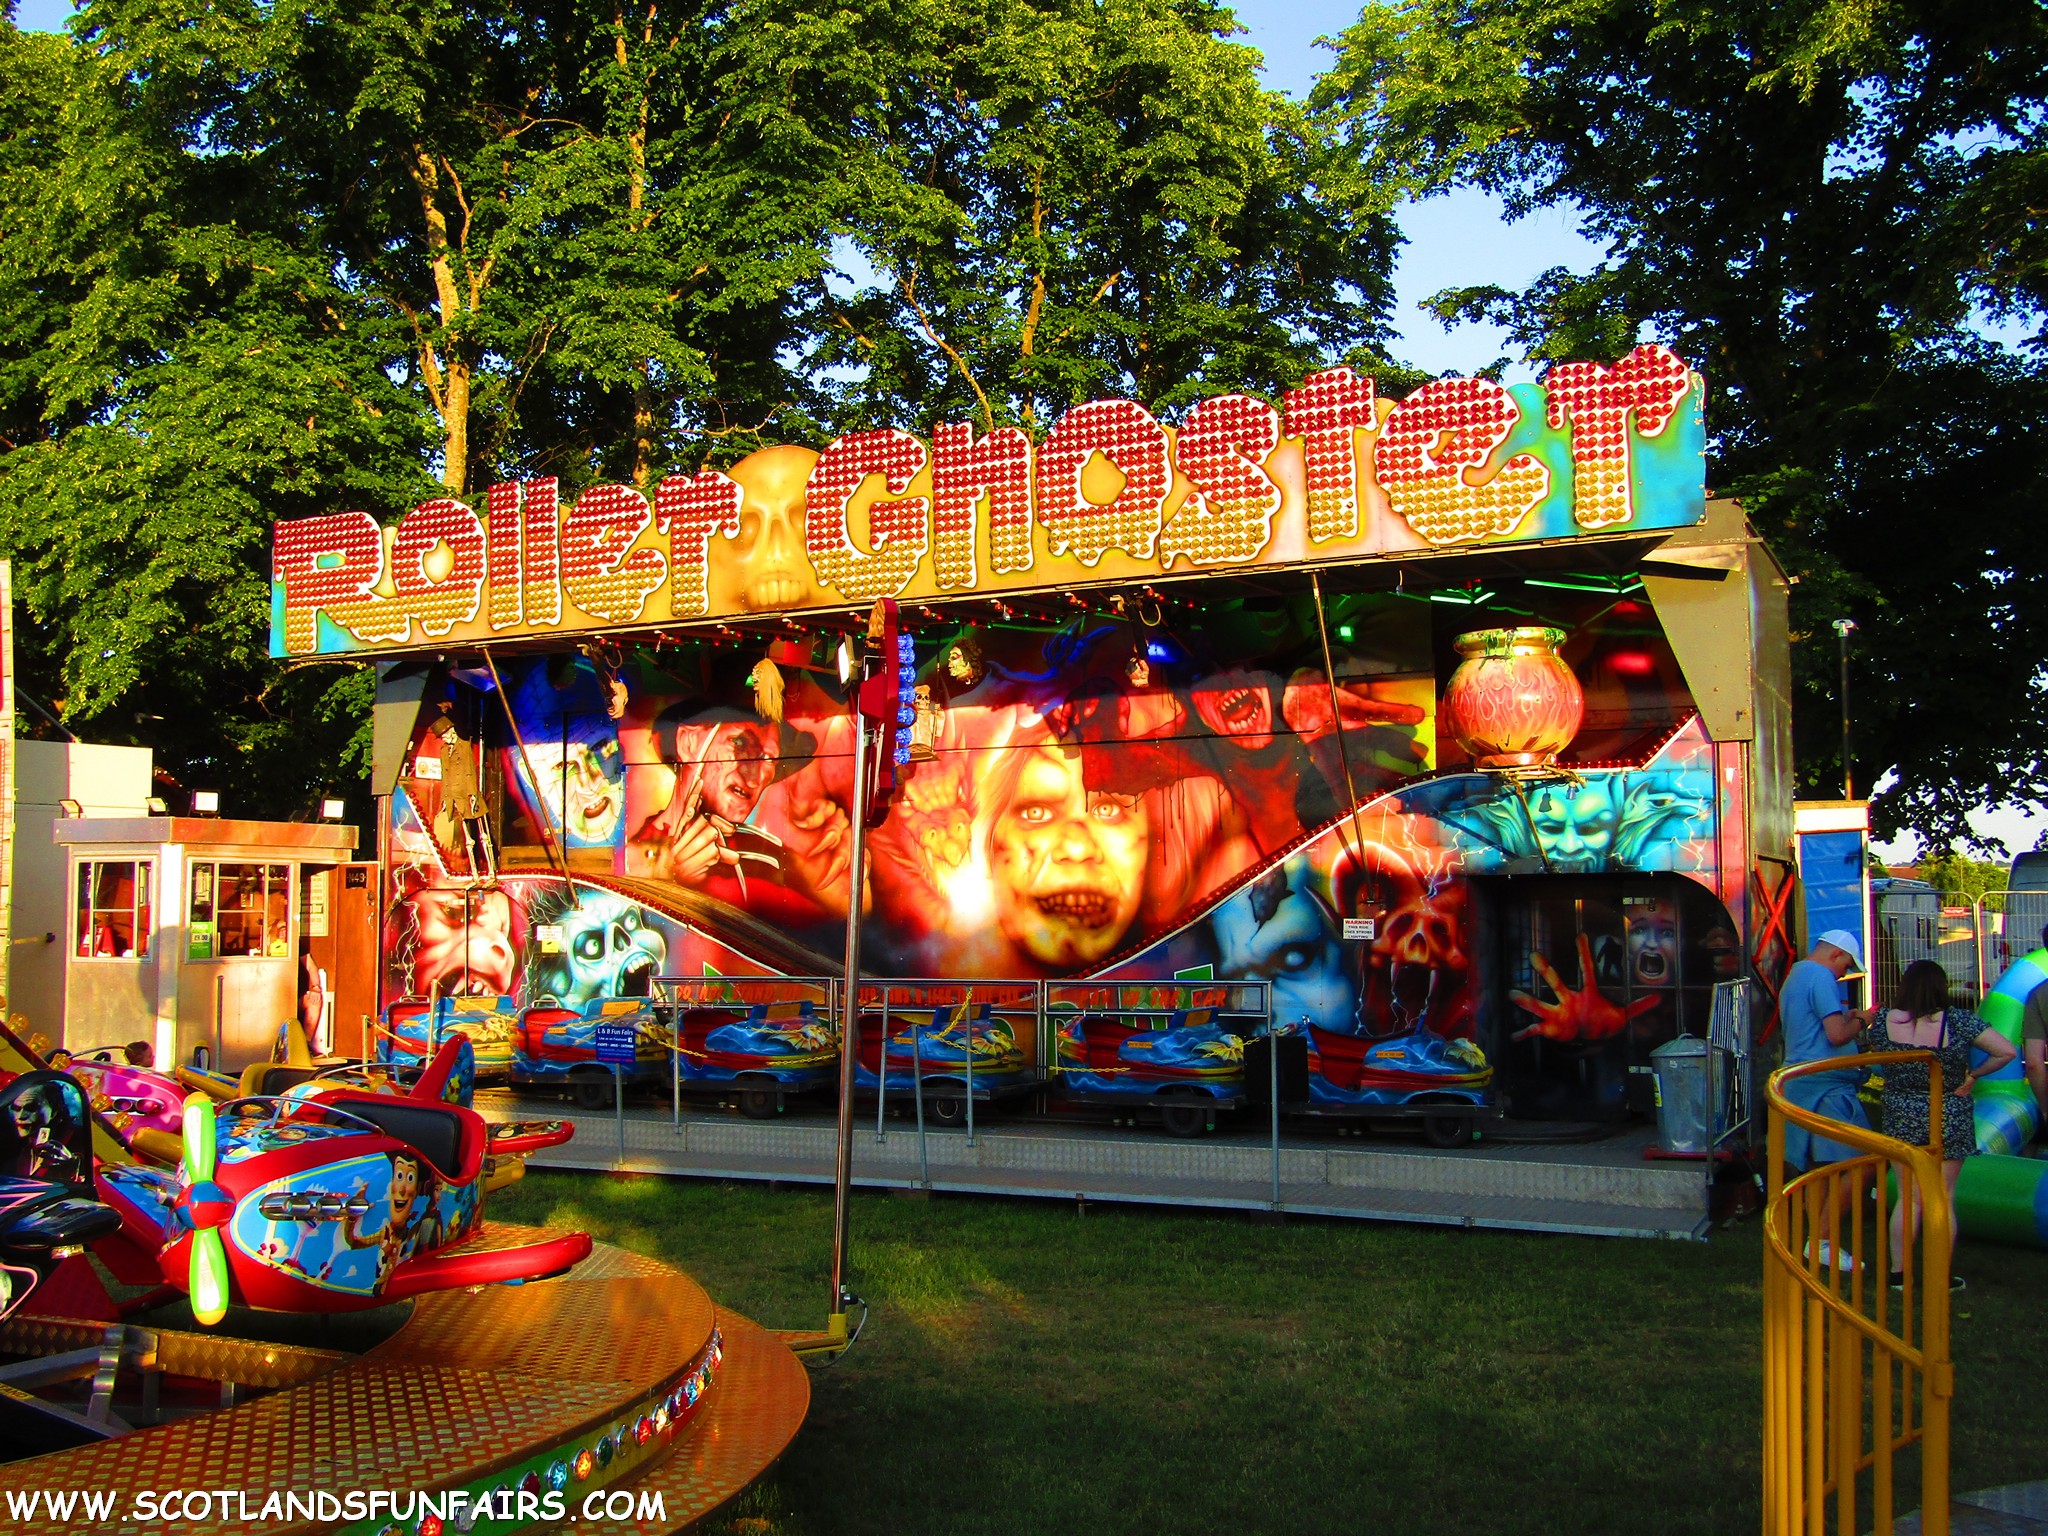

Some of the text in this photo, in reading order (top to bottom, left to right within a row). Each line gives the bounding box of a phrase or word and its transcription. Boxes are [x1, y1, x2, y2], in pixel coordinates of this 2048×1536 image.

[272, 344, 1690, 655] Roller Ghoster
[677, 984, 692, 1000] DO
[699, 984, 724, 1000] NOT
[731, 984, 774, 1000] STAND
[1121, 990, 1140, 1006] IN
[1151, 989, 1181, 1007] THE
[1192, 989, 1227, 1007] CAR
